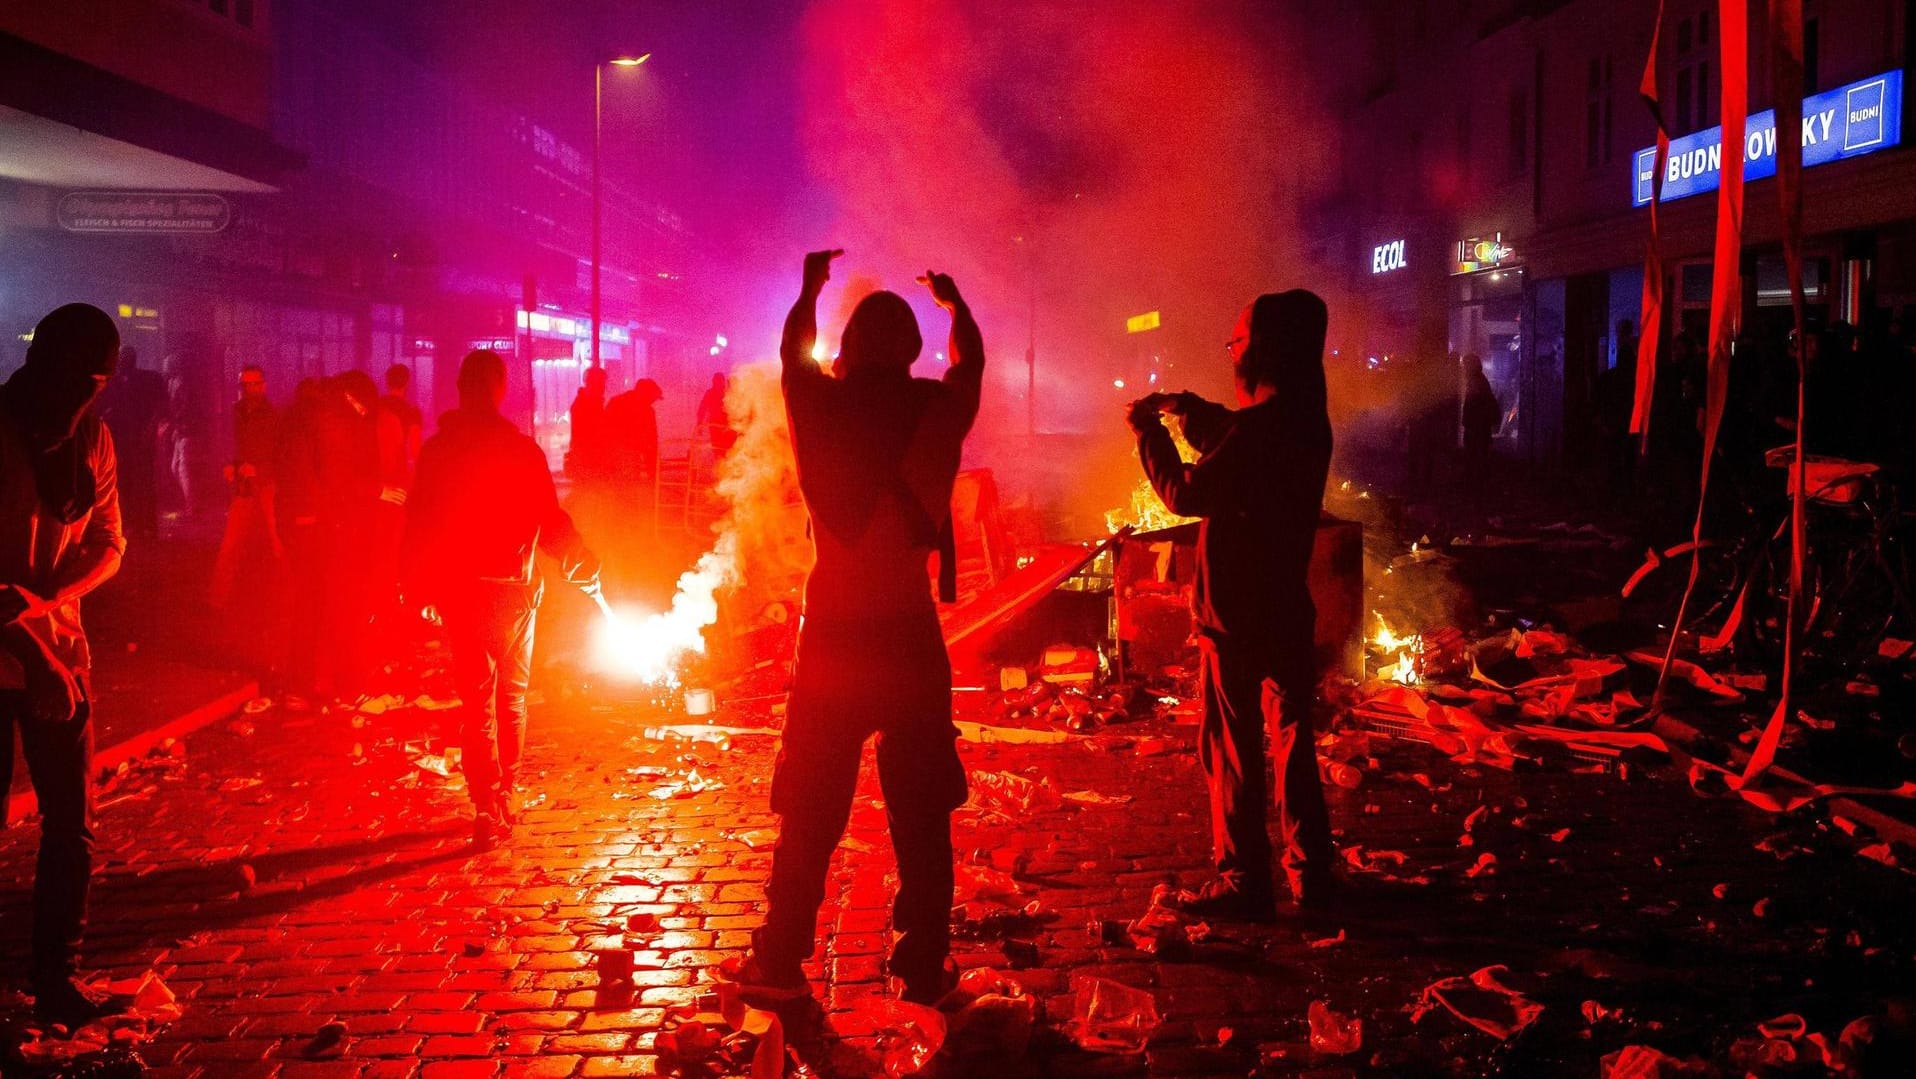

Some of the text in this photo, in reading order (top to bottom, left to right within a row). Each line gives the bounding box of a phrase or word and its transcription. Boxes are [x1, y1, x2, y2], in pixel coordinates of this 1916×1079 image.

[1850, 106, 1879, 124] BUDNI
[1668, 109, 1835, 182] BUDNOWKY
[74, 218, 214, 228] FLEISCH & FISCH SPEZIALITÄTEN
[1372, 239, 1407, 274] ECOL
